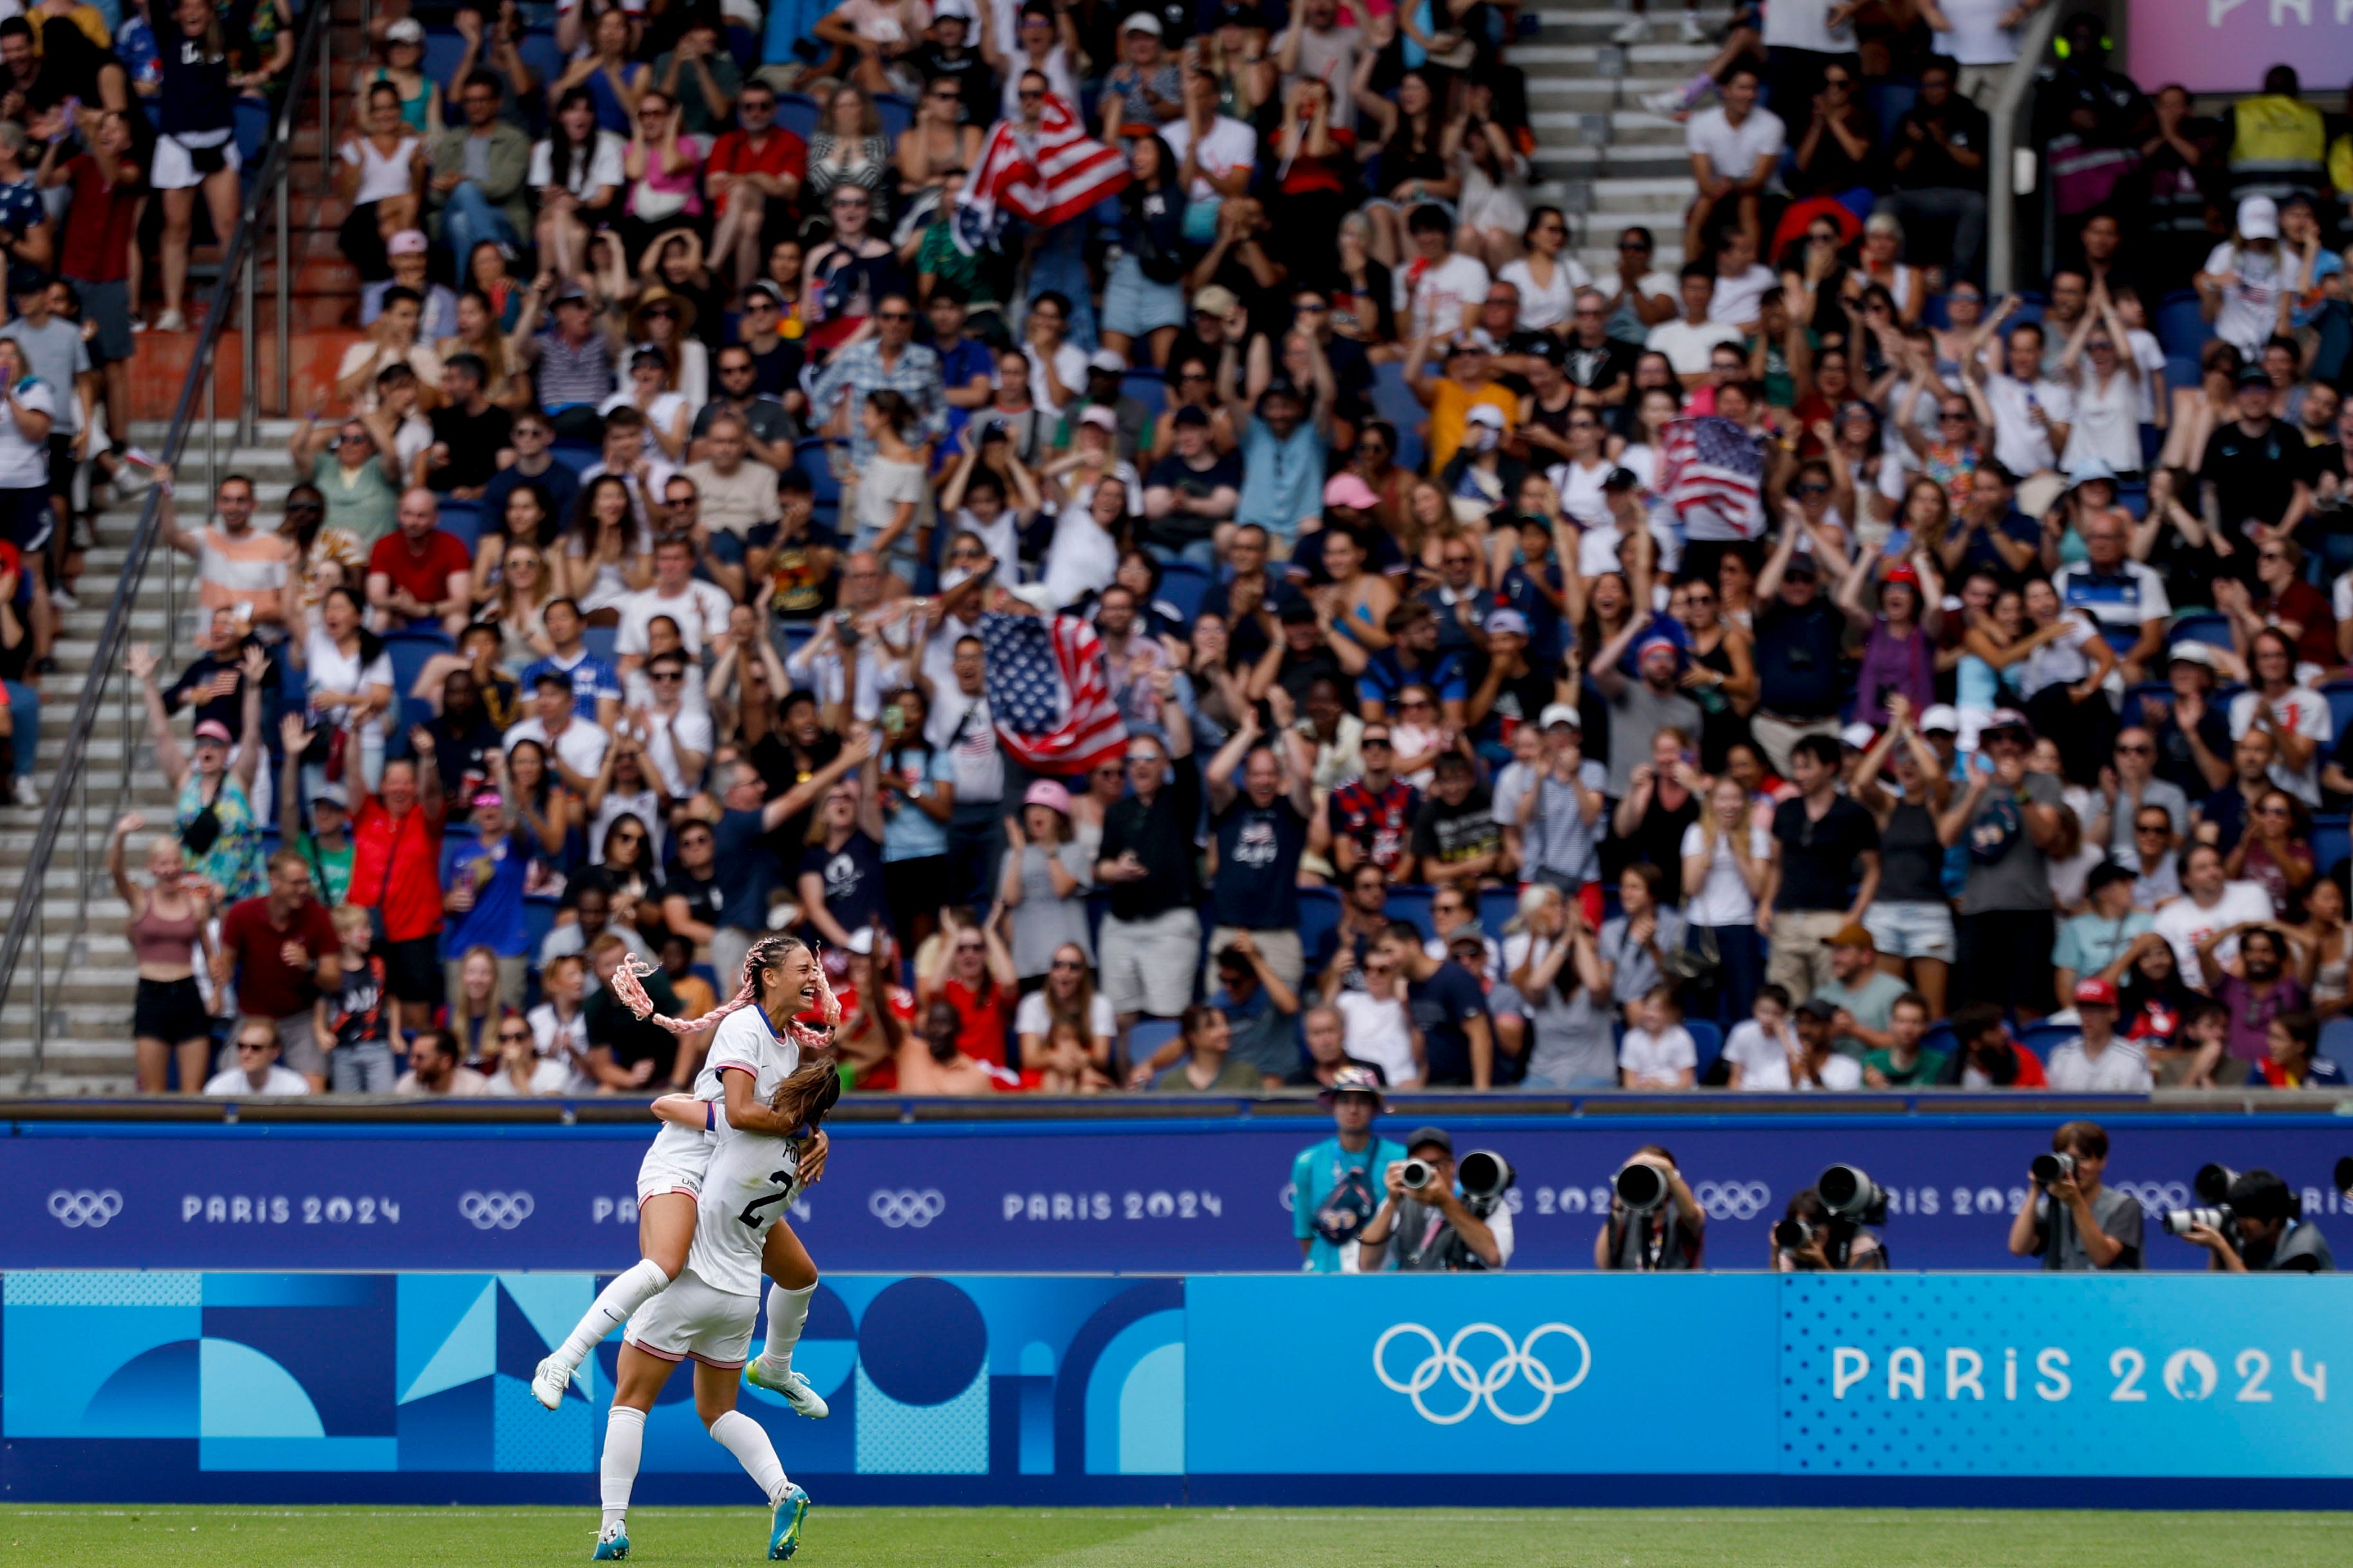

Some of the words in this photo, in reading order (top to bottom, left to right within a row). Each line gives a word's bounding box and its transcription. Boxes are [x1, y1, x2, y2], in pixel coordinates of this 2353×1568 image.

[301, 1194, 400, 1224] 2024
[738, 1170, 793, 1229] 2
[1122, 1190, 1222, 1220] 2024
[1535, 1186, 1612, 1215] 202
[1951, 1186, 2027, 1215] 202
[2110, 1347, 2327, 1403] 2024
